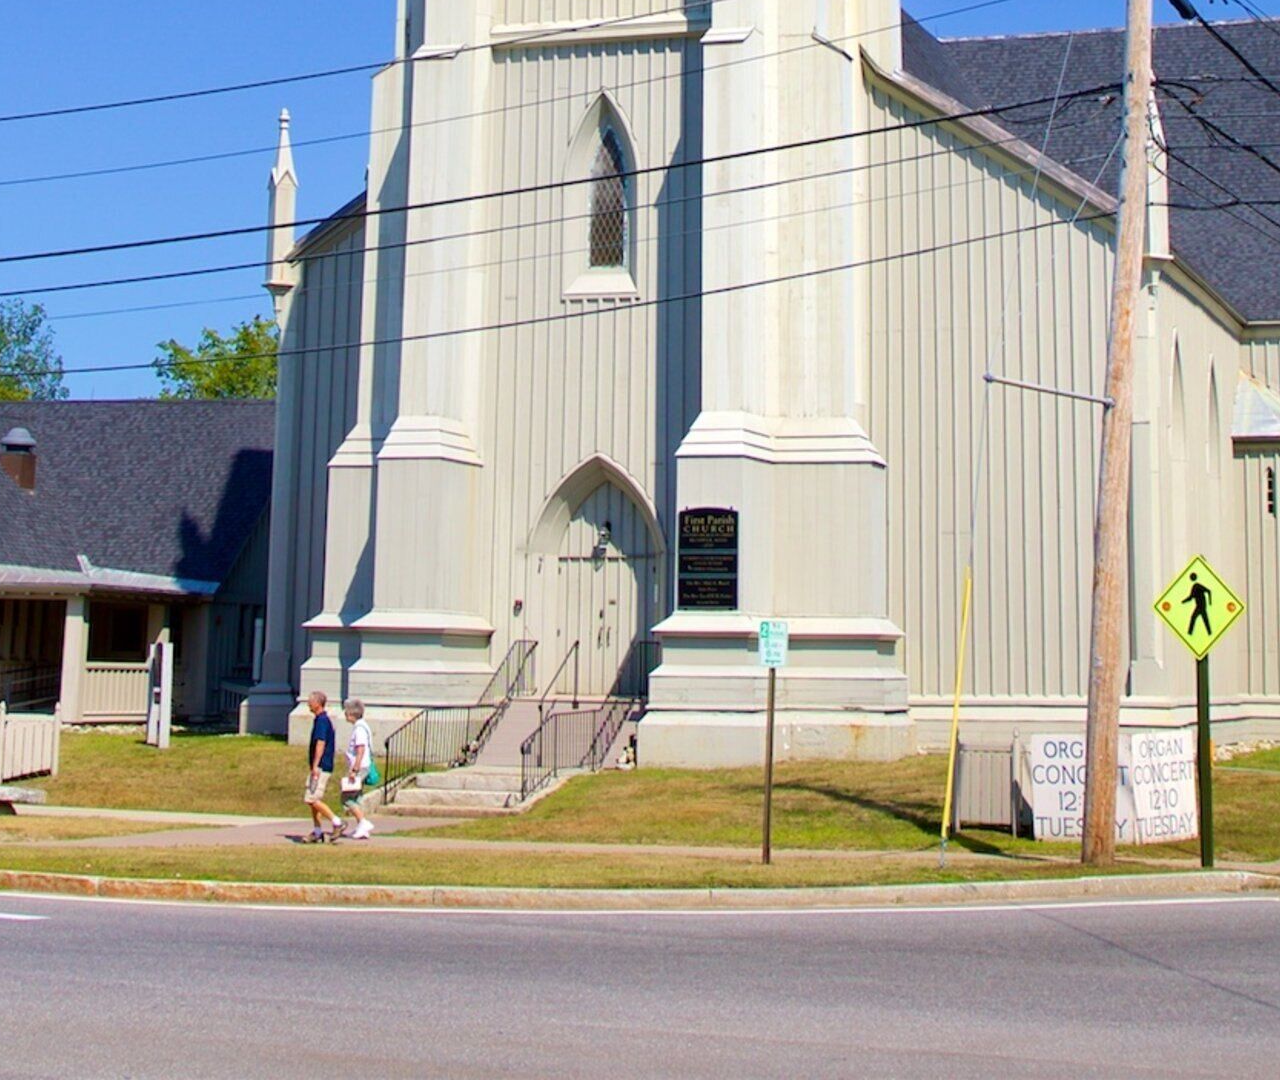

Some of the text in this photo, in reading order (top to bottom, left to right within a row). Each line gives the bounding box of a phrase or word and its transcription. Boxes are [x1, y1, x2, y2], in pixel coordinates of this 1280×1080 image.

[682, 525, 735, 534] CHURCH
[1043, 741, 1083, 759] ORG
[1139, 739, 1183, 758] ORGAN
[1032, 764, 1129, 786] CONCT
[1134, 760, 1194, 785] CONCERT
[1036, 817, 1128, 839] TUESY
[1136, 812, 1193, 837] TUESDAY
